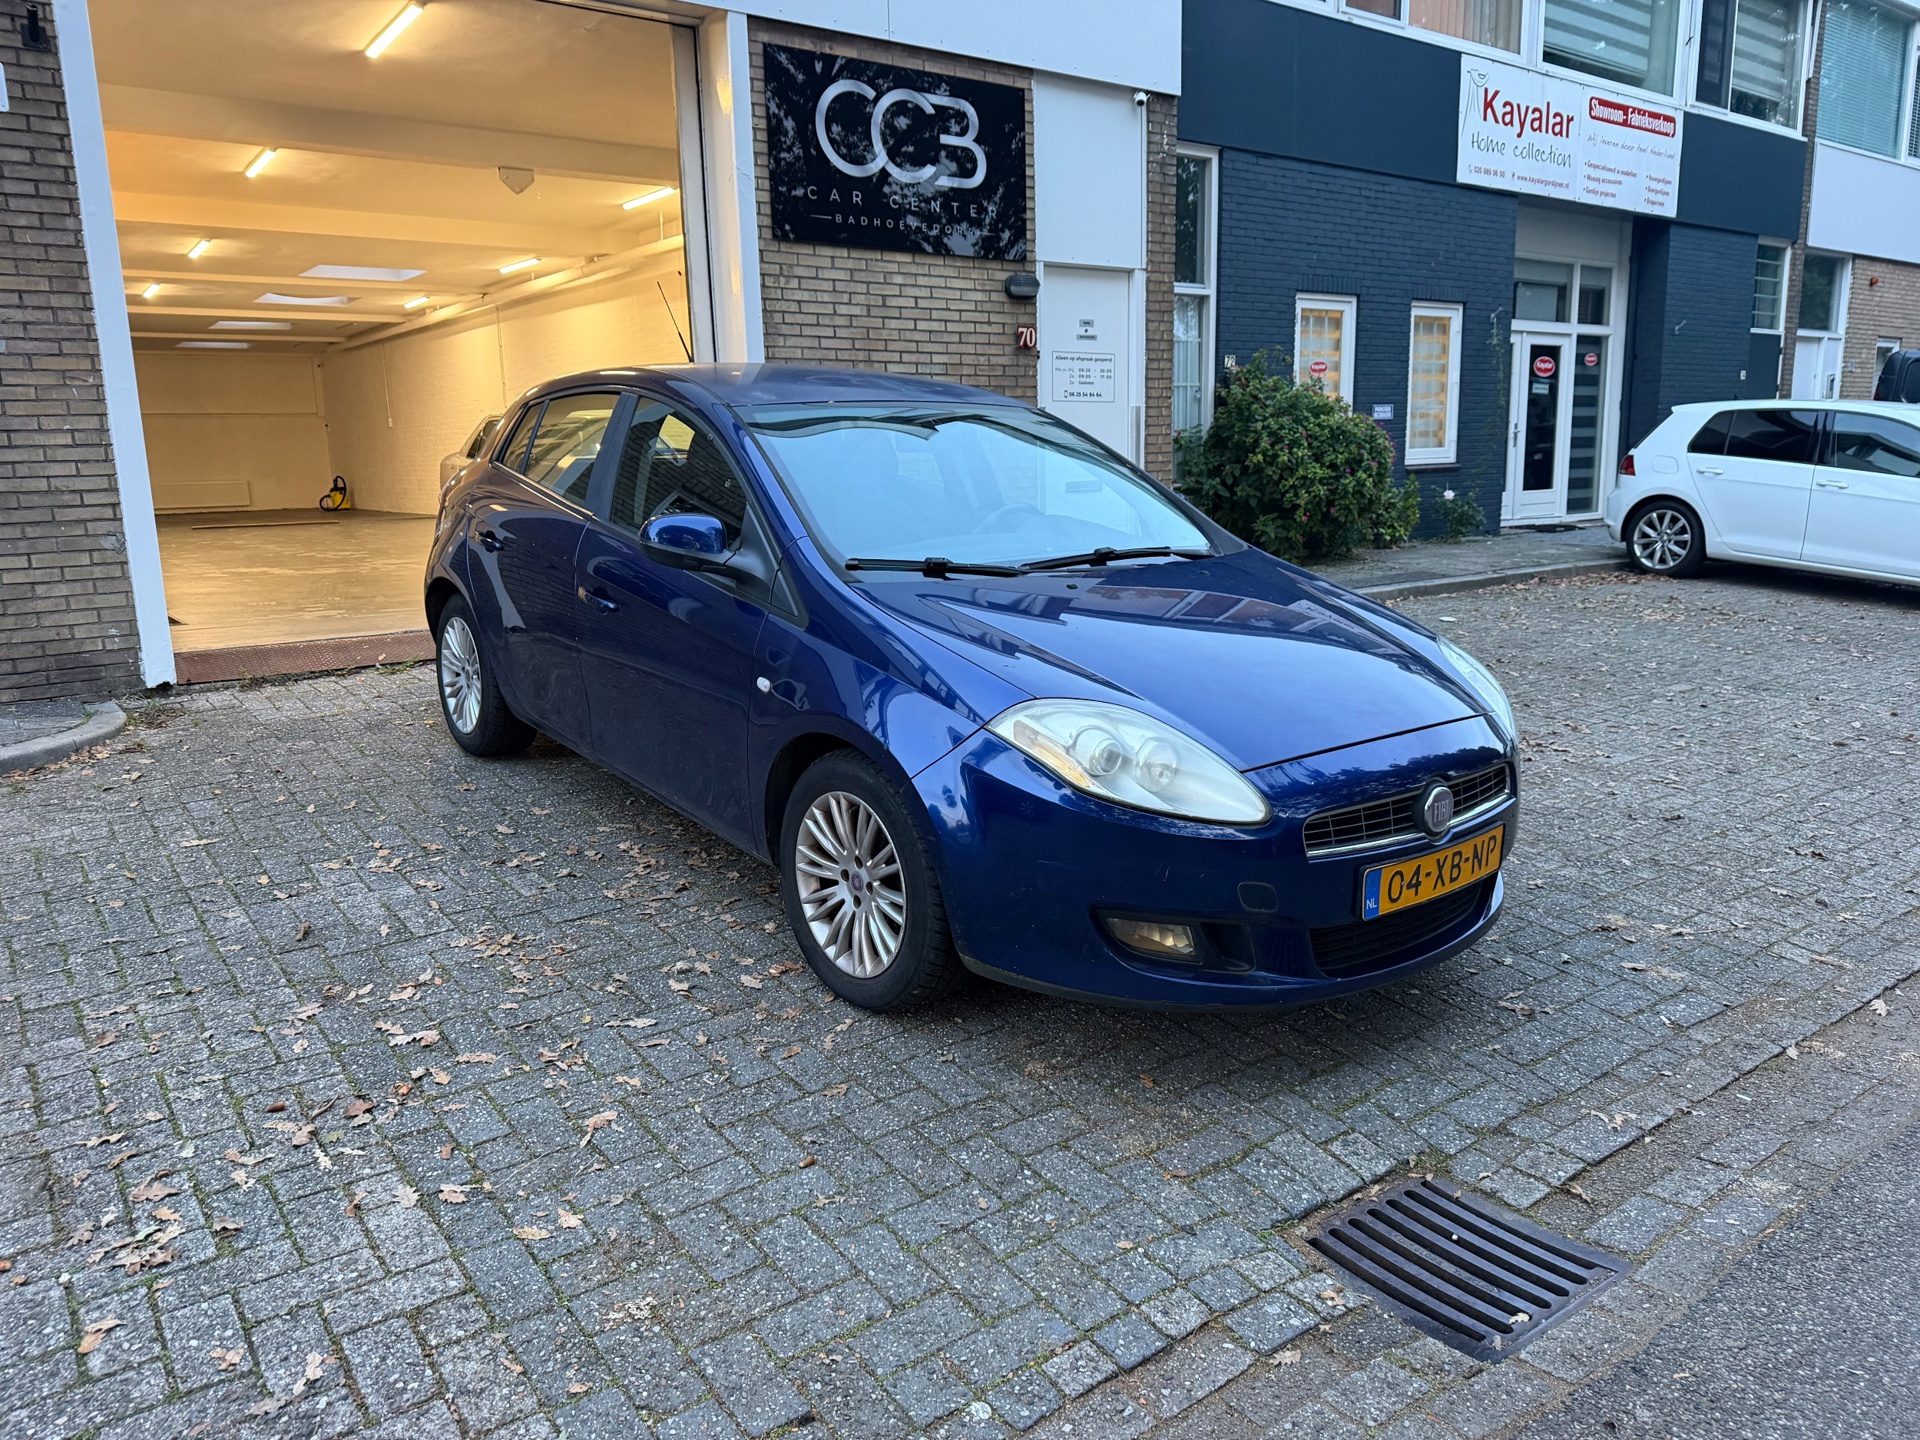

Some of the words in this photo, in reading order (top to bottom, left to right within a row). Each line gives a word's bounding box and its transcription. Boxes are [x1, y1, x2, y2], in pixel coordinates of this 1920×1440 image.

[1482, 87, 1575, 139] Kayalar
[1591, 98, 1627, 123] Showroom-
[1627, 107, 1675, 138] Fabrieksverkoop
[815, 79, 987, 189] CCB
[1471, 131, 1506, 156] Home
[1513, 141, 1572, 168] collection
[1600, 135, 1619, 148] leveren
[1620, 141, 1635, 151] door
[807, 186, 863, 206] CAR
[889, 195, 997, 220] CENTER
[1018, 327, 1036, 347] 70
[1433, 800, 1451, 823] FIAT
[1387, 833, 1497, 904] 04-XB-NP
[1366, 897, 1378, 910] NL
